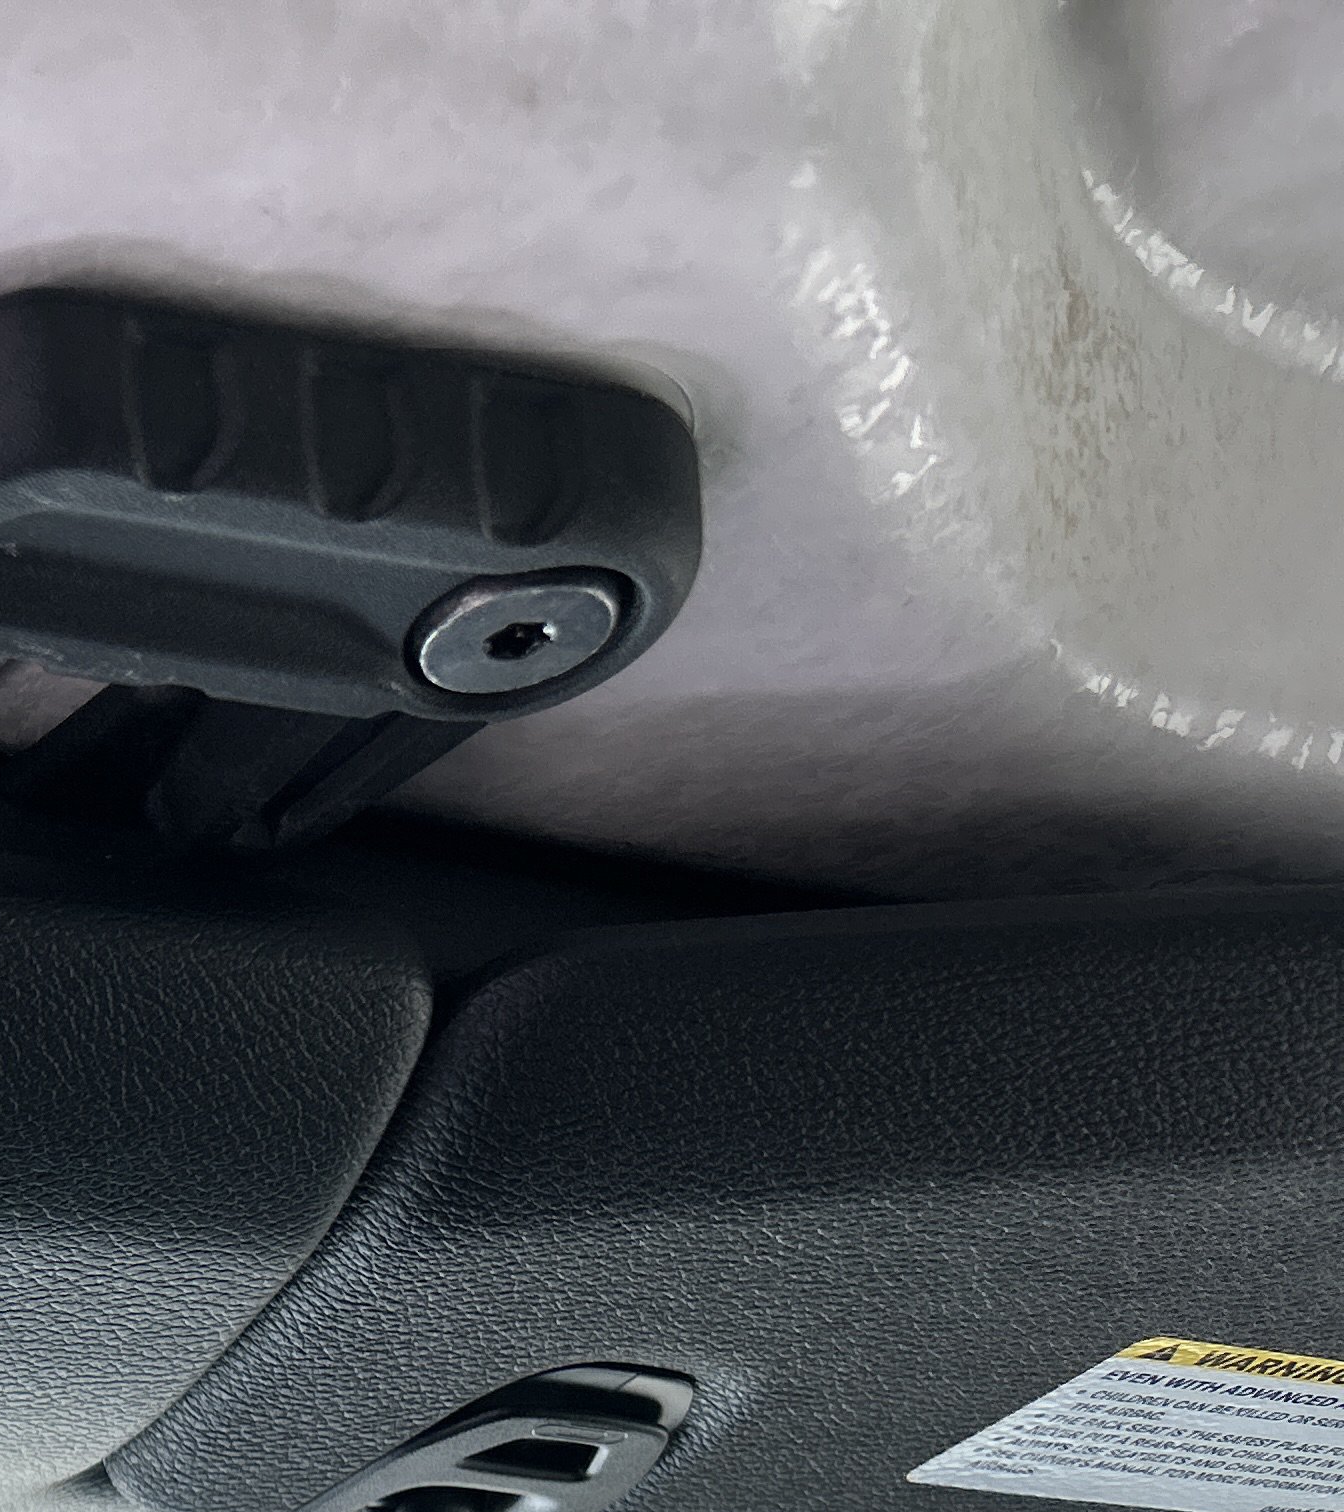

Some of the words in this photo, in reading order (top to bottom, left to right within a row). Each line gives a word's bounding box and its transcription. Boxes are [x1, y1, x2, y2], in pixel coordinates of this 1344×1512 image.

[1101, 1370, 1166, 1385] EVEN
[1164, 1378, 1226, 1392] WITH
[1220, 1386, 1338, 1406] ADVANCED
[1070, 1402, 1108, 1413] THE
[1090, 1390, 1176, 1406] CHILDREN
[1172, 1400, 1212, 1411] CAN
[1230, 1408, 1290, 1421] KILLED
[1288, 1414, 1316, 1424] OR
[1126, 1424, 1170, 1434] SEAT
[1164, 1428, 1188, 1437] IS
[1186, 1430, 1221, 1441] THE
[1216, 1434, 1280, 1448] SAFEST
[1274, 1442, 1328, 1454] PLACE
[1188, 1458, 1226, 1468] AND
[1224, 1462, 1274, 1474] CHILD
[1230, 1450, 1282, 1462] CHILD
[1278, 1456, 1322, 1466] SEAT
[1316, 1460, 1341, 1468] IN
